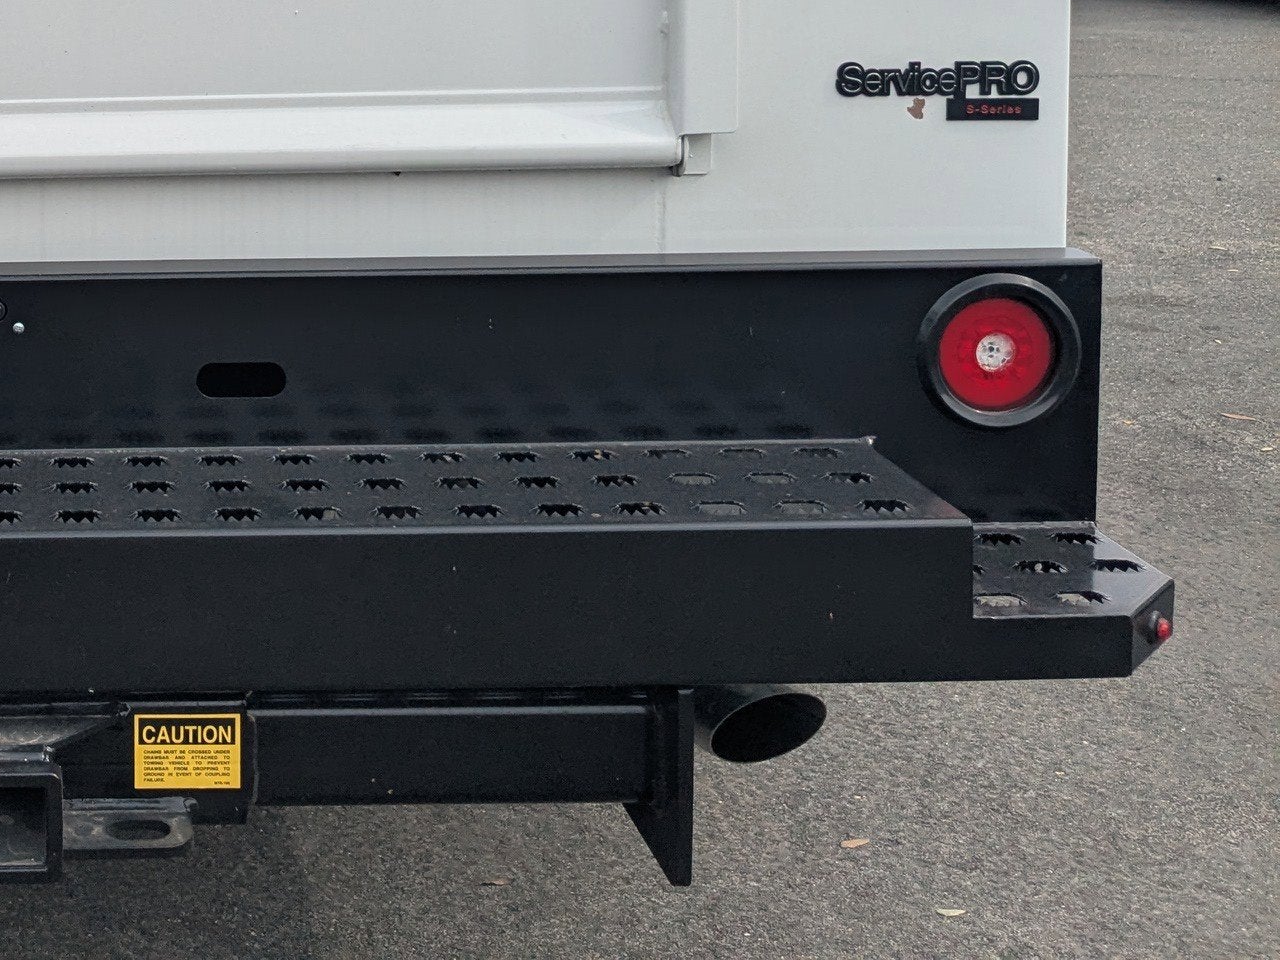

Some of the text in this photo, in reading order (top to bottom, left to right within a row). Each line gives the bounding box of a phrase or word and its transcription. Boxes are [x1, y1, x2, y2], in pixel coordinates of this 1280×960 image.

[835, 60, 1040, 97] ServicePRO
[966, 104, 1022, 114] S-Series
[142, 725, 232, 744] CAUTION
